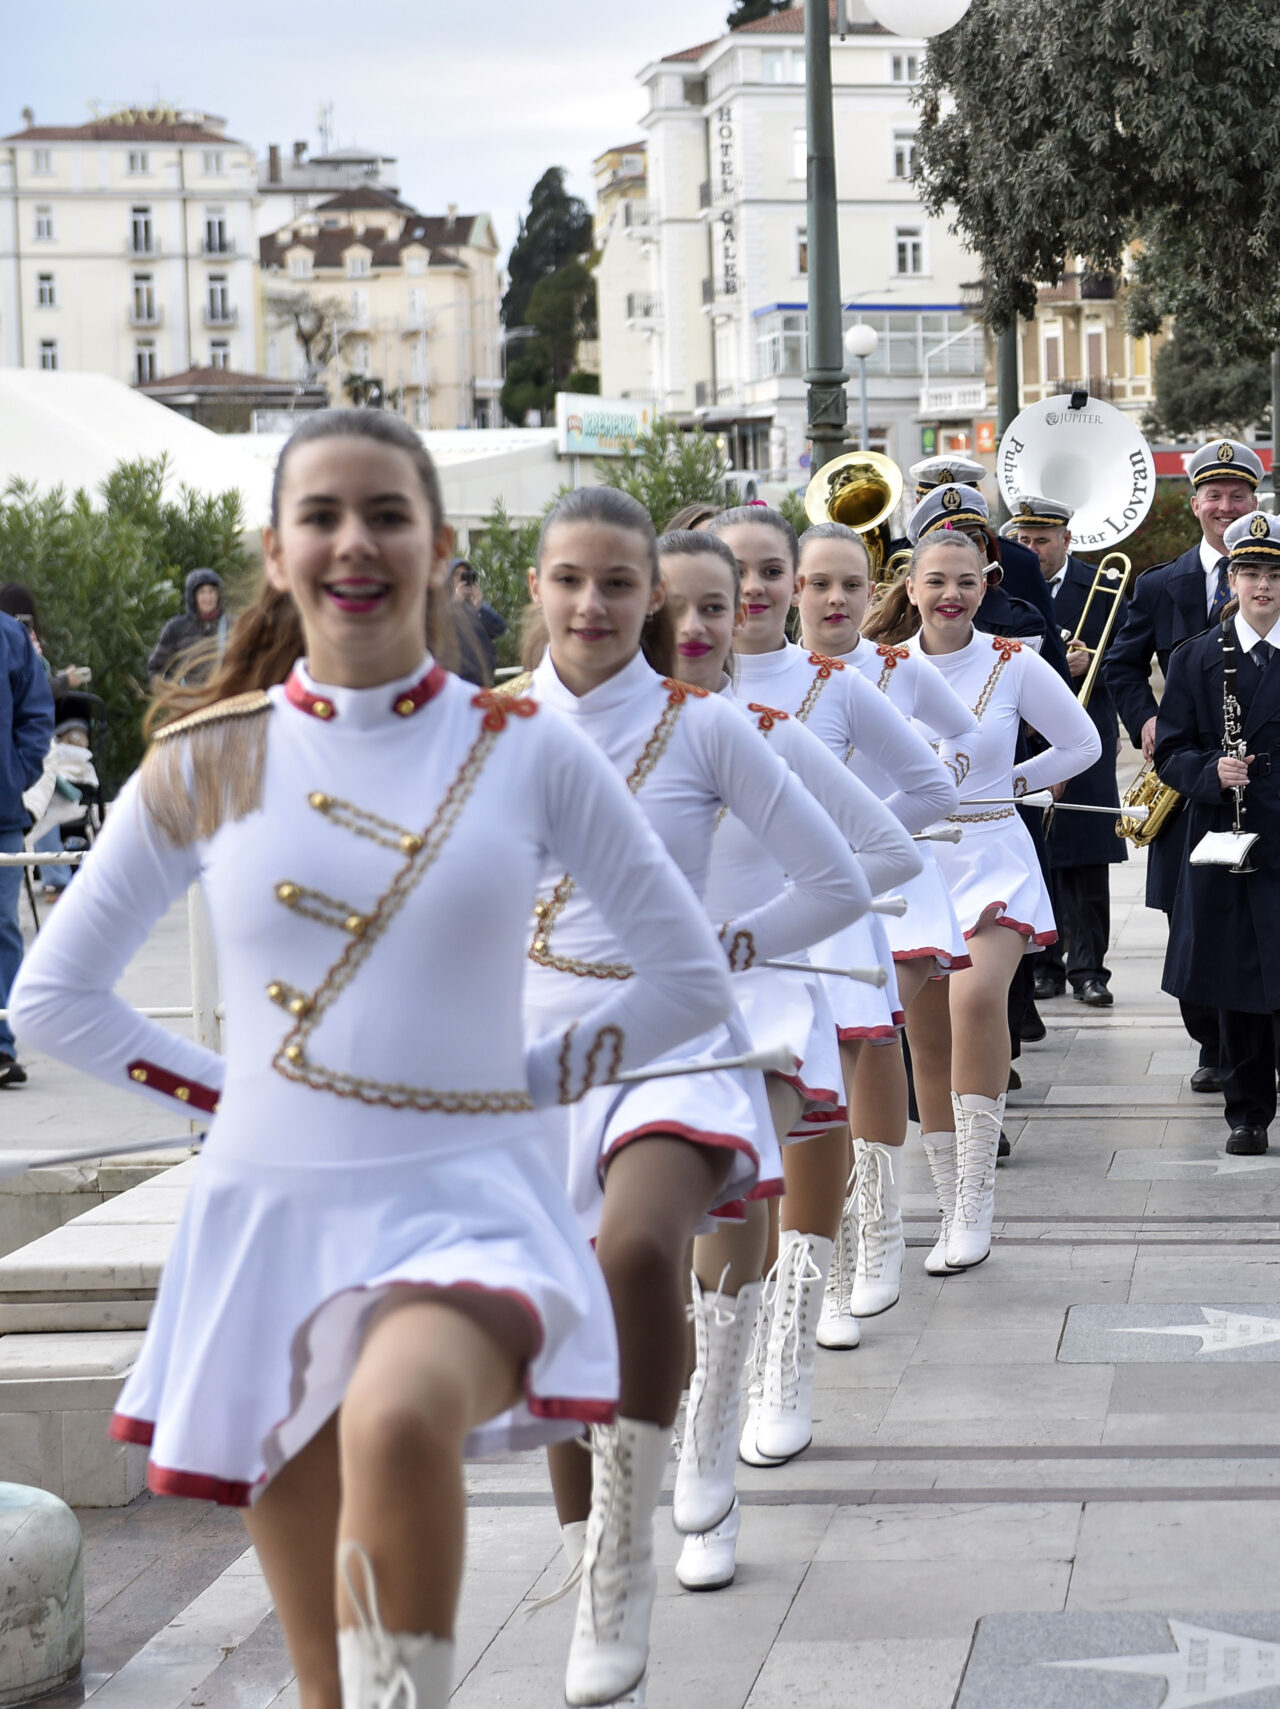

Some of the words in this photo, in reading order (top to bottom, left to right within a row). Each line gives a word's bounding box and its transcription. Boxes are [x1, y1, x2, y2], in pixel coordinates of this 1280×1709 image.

[718, 106, 734, 193] HOTEL
[1060, 412, 1101, 425] JUPITER
[1003, 435, 1024, 500] Puhač
[1070, 531, 1107, 545] star
[1103, 449, 1148, 535] Lovran
